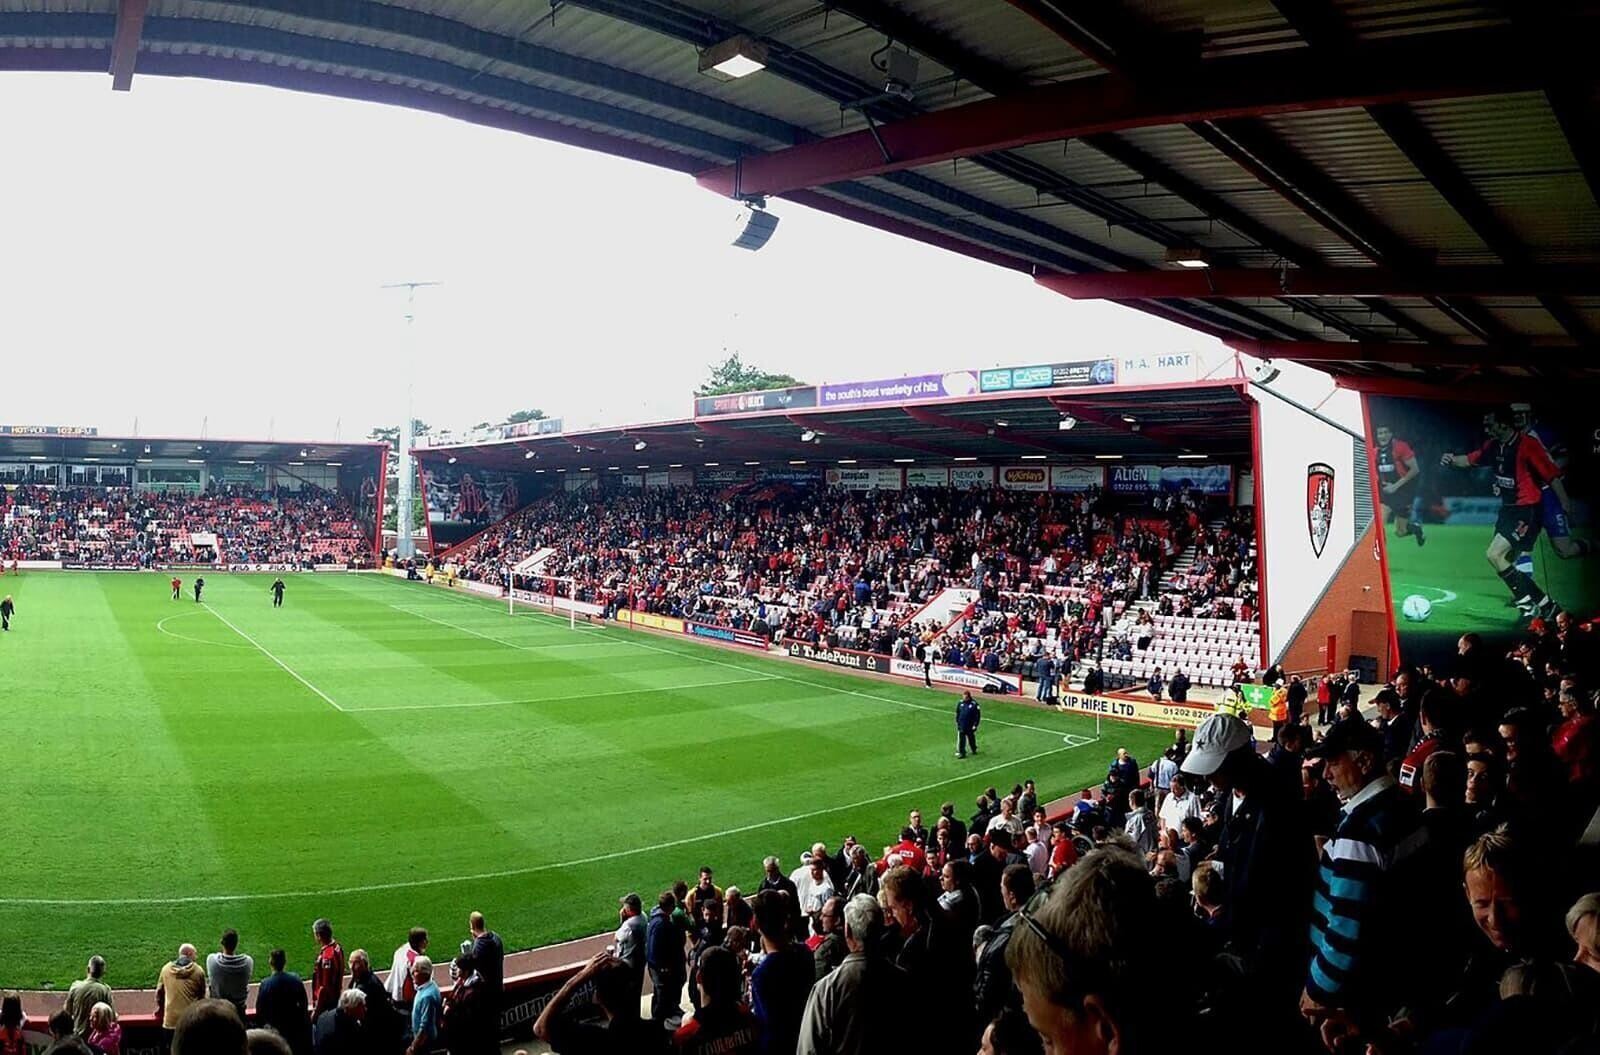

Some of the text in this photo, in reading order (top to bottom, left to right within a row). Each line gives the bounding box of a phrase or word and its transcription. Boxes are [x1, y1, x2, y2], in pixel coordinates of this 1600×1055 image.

[1157, 355, 1190, 367] HART
[983, 372, 1010, 384] CAR
[825, 381, 938, 401] the south's best variety of hits
[1113, 468, 1148, 481] ALIGN
[803, 645, 861, 667] TradePoint
[1081, 698, 1108, 713] HIRE
[1111, 702, 1135, 716] LTD
[1163, 707, 1190, 717] 01202
